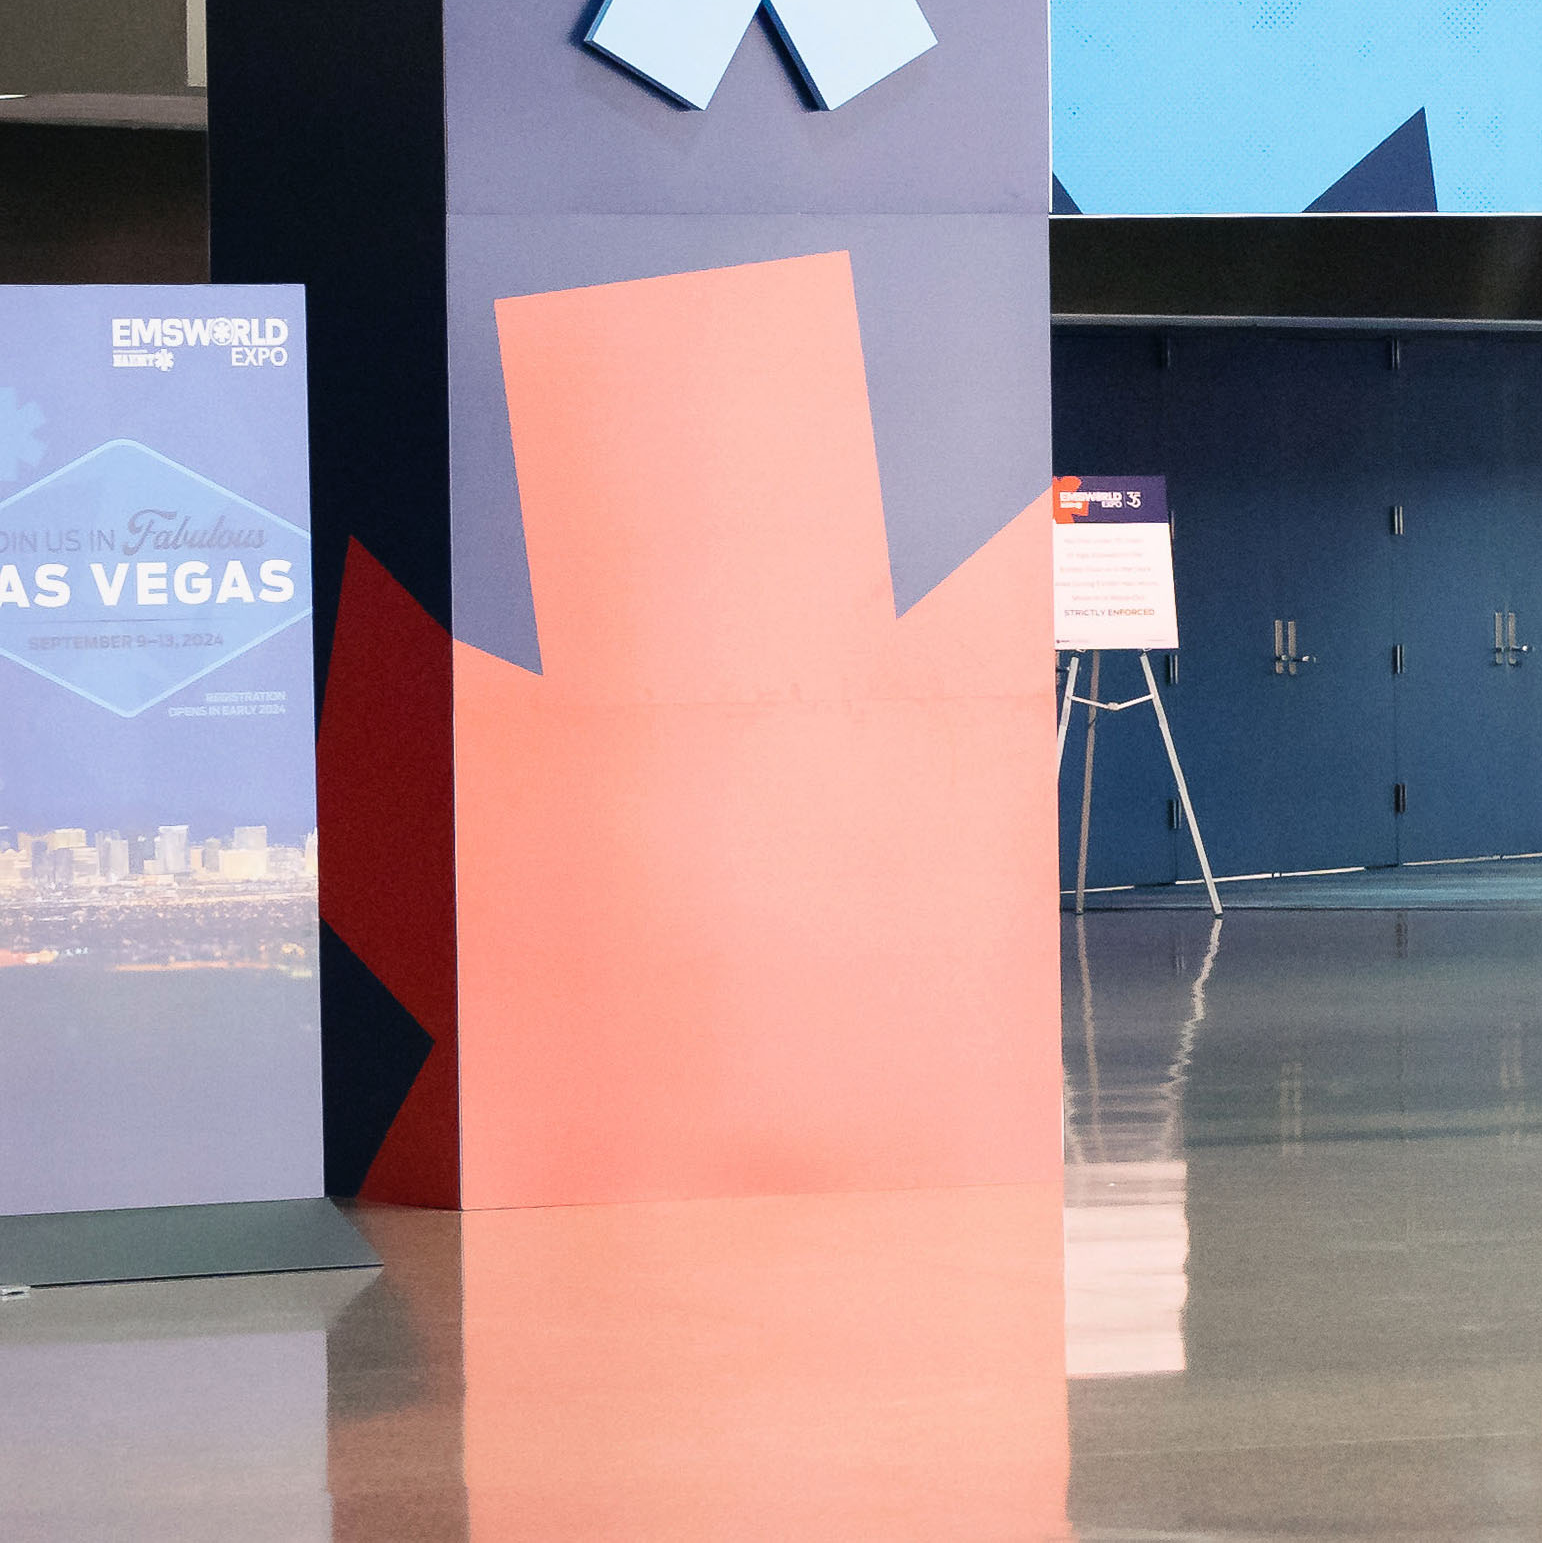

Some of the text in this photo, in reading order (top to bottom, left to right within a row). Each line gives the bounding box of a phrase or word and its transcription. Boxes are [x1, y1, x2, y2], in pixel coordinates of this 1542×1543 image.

[231, 346, 288, 366] EXPO
[46, 529, 81, 553] US
[91, 529, 115, 551] IN
[122, 509, 268, 556] Fabulous
[90, 559, 295, 606] VEGAS
[28, 635, 131, 651] SEPTEMBER
[182, 633, 223, 647] 2024
[168, 706, 207, 716] OPENS
[223, 705, 256, 715] EARLY
[259, 704, 286, 714] 2024
